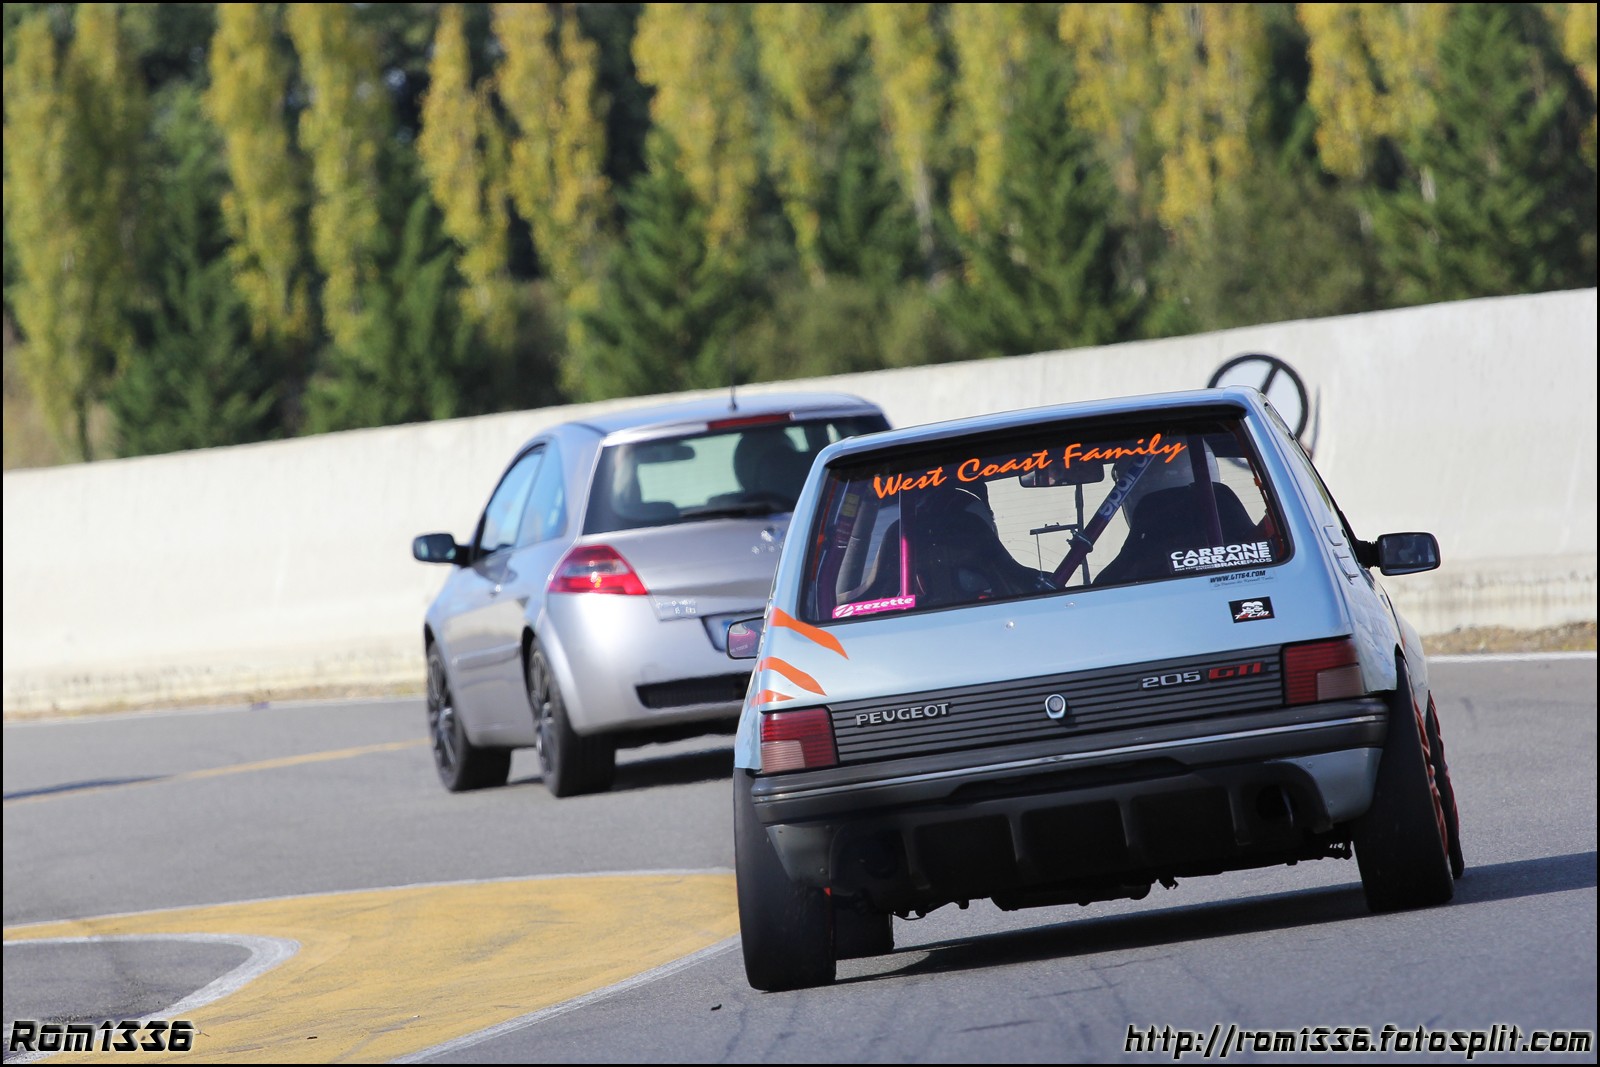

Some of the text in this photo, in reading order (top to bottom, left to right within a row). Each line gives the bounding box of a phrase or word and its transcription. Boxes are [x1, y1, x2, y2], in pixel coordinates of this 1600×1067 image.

[873, 433, 1187, 499] West Coast Family
[1170, 541, 1268, 560] CARBONE
[1173, 550, 1271, 569] LORRAINE
[855, 597, 914, 611] zezette
[1142, 661, 1263, 689] 205 GTI
[855, 702, 951, 727] PEUGEOT
